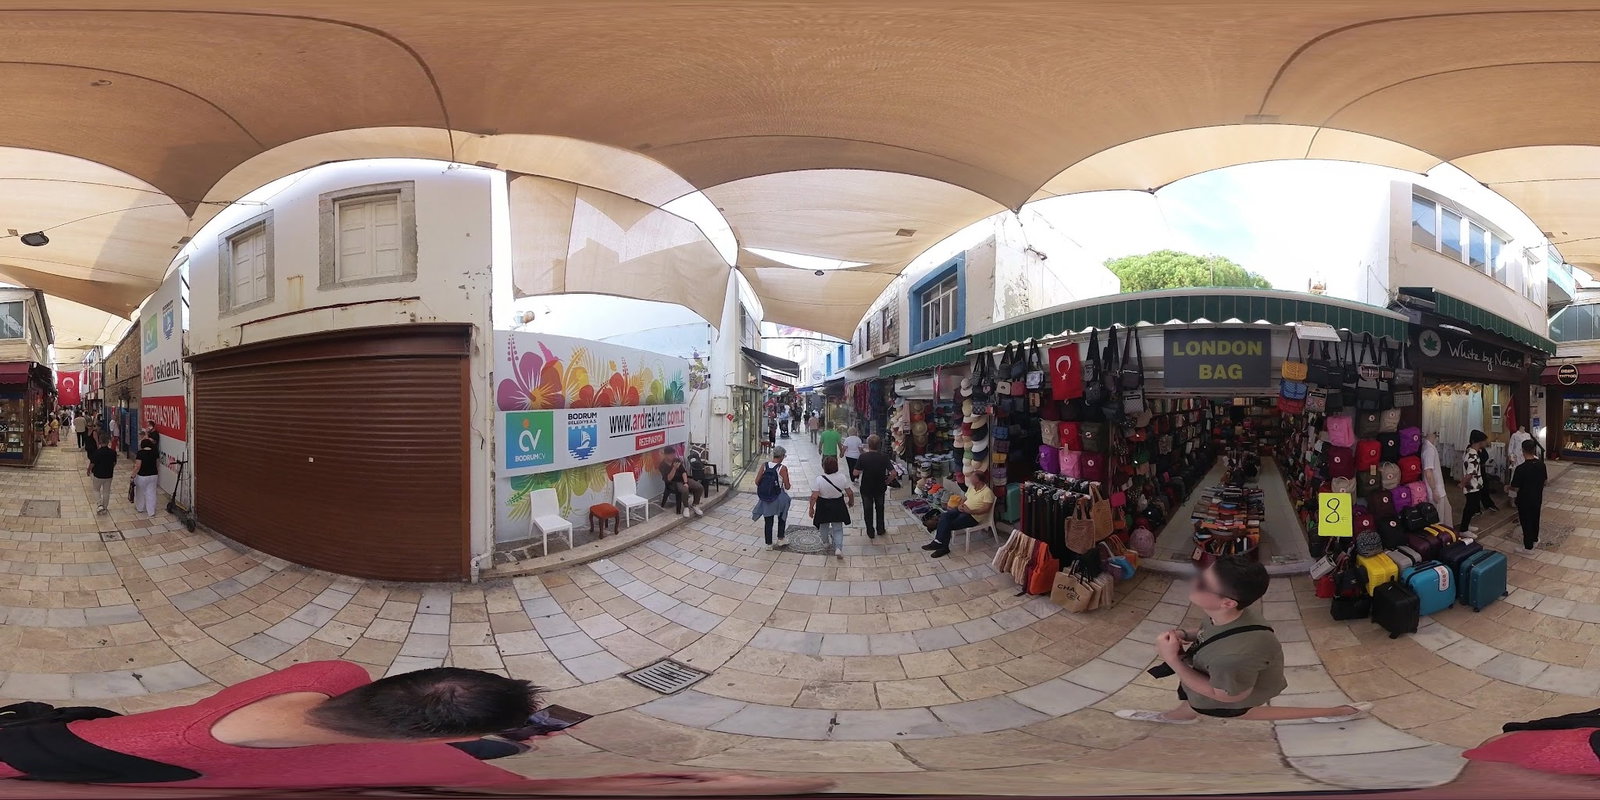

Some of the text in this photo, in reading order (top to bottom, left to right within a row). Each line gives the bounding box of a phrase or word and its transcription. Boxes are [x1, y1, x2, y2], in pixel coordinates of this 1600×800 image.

[1173, 340, 1262, 356] LONDON
[1447, 339, 1480, 361] White
[1482, 352, 1493, 372] by
[1199, 364, 1243, 380] BAG
[567, 412, 598, 421] BODRUM
[1325, 497, 1341, 524] 8
